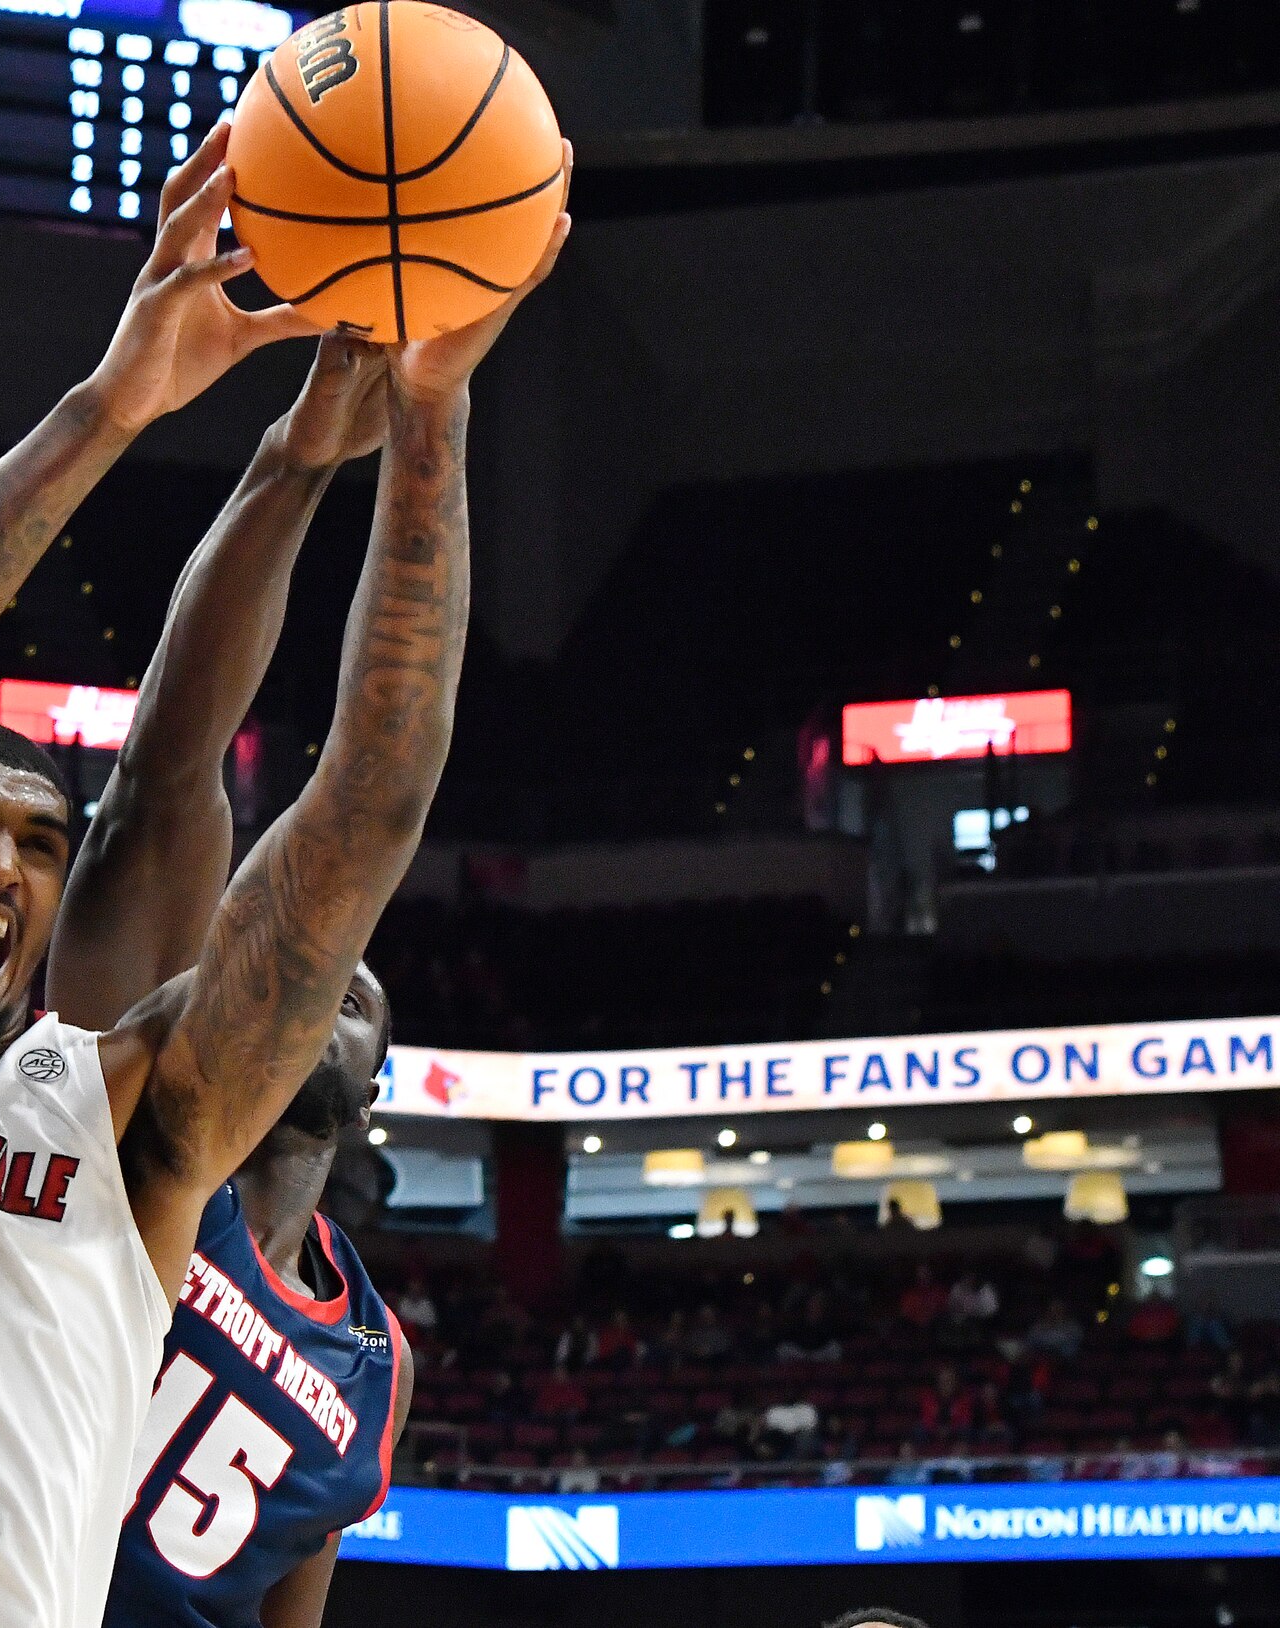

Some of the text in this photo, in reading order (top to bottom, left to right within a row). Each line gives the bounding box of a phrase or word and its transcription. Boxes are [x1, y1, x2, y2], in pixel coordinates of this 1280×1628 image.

[531, 1033, 1273, 1107] FOR THE FANS ON GAM
[272, 1339, 359, 1458] MERCY
[122, 1350, 294, 1580] 15
[1082, 1502, 1280, 1537] HEALTHCAR
